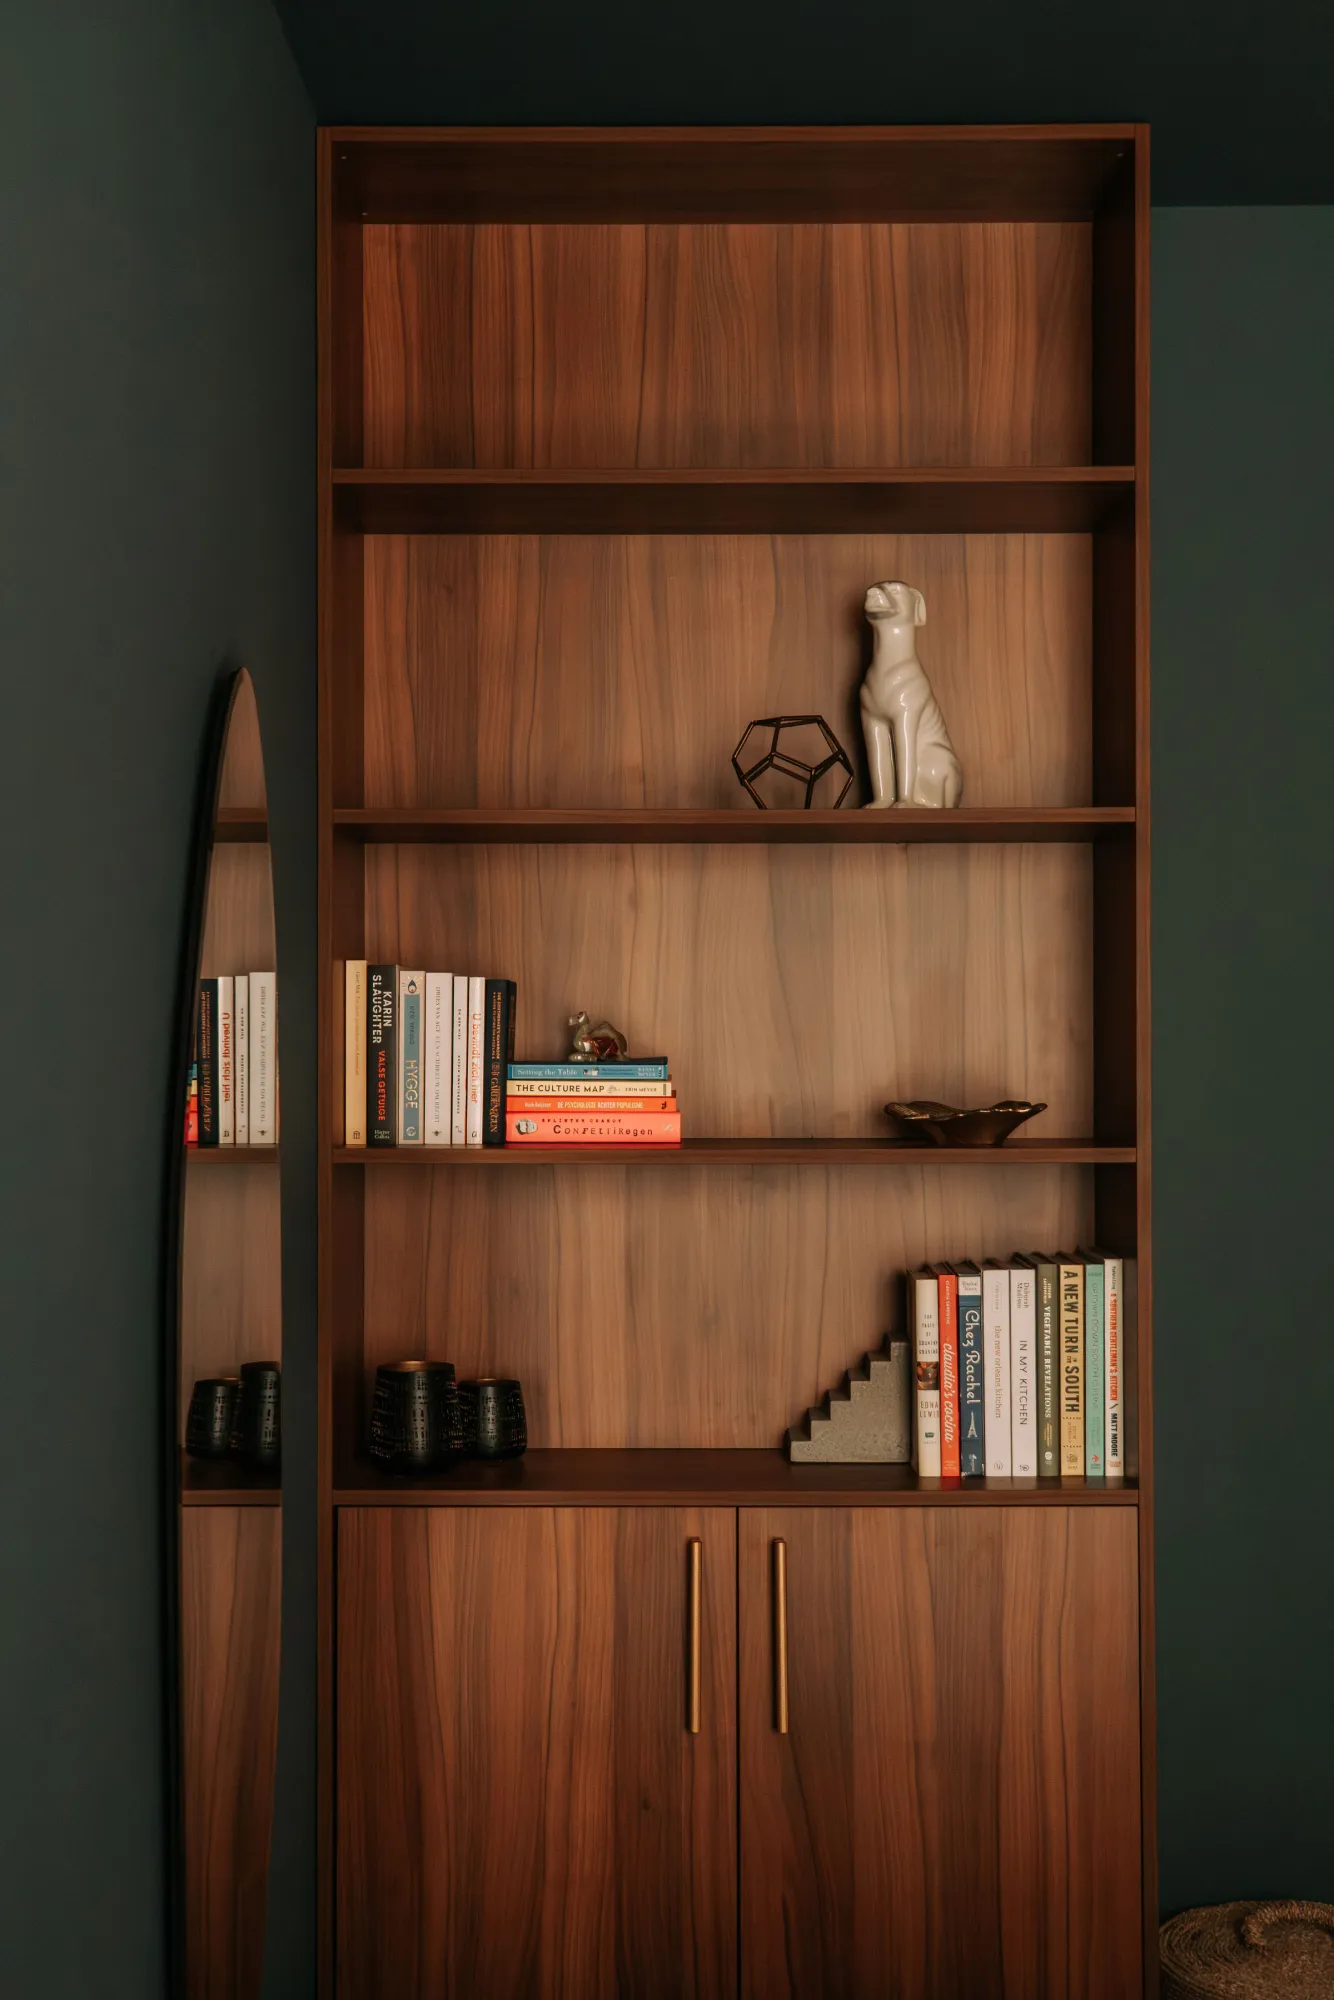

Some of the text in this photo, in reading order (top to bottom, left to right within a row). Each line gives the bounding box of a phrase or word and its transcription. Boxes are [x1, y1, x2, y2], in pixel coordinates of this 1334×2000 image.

[372, 974, 382, 1044] SLAUGHTER
[382, 991, 392, 1027] KARIN
[471, 1013, 481, 1104] U bevindt zich hier
[517, 1068, 543, 1076] Setting
[378, 1050, 386, 1121] VALSE GETUIGE
[405, 1059, 418, 1109] HYGGE
[516, 1084, 605, 1093] THE CULTURE MAP
[564, 1101, 597, 1109] PSYCHOLOGIE
[597, 1101, 616, 1109] ACHTER
[616, 1101, 644, 1109] POPULISME
[1043, 1306, 1051, 1356] VEGETABLE
[1064, 1270, 1079, 1353] A NEW TURN
[962, 1309, 981, 1404] Chez Rachel
[994, 1357, 1002, 1387] orleans
[1110, 1331, 1118, 1374] GENTLEMAN'S
[920, 1401, 939, 1409] EDNA
[943, 1343, 956, 1442] claudia's cocina
[995, 1388, 1003, 1419] kitchen
[1019, 1340, 1028, 1426] IN MY KITCHEN
[1044, 1358, 1052, 1418] REVELATIONS
[1065, 1365, 1080, 1413] SOUTH
[1110, 1375, 1118, 1401] KITCHEN
